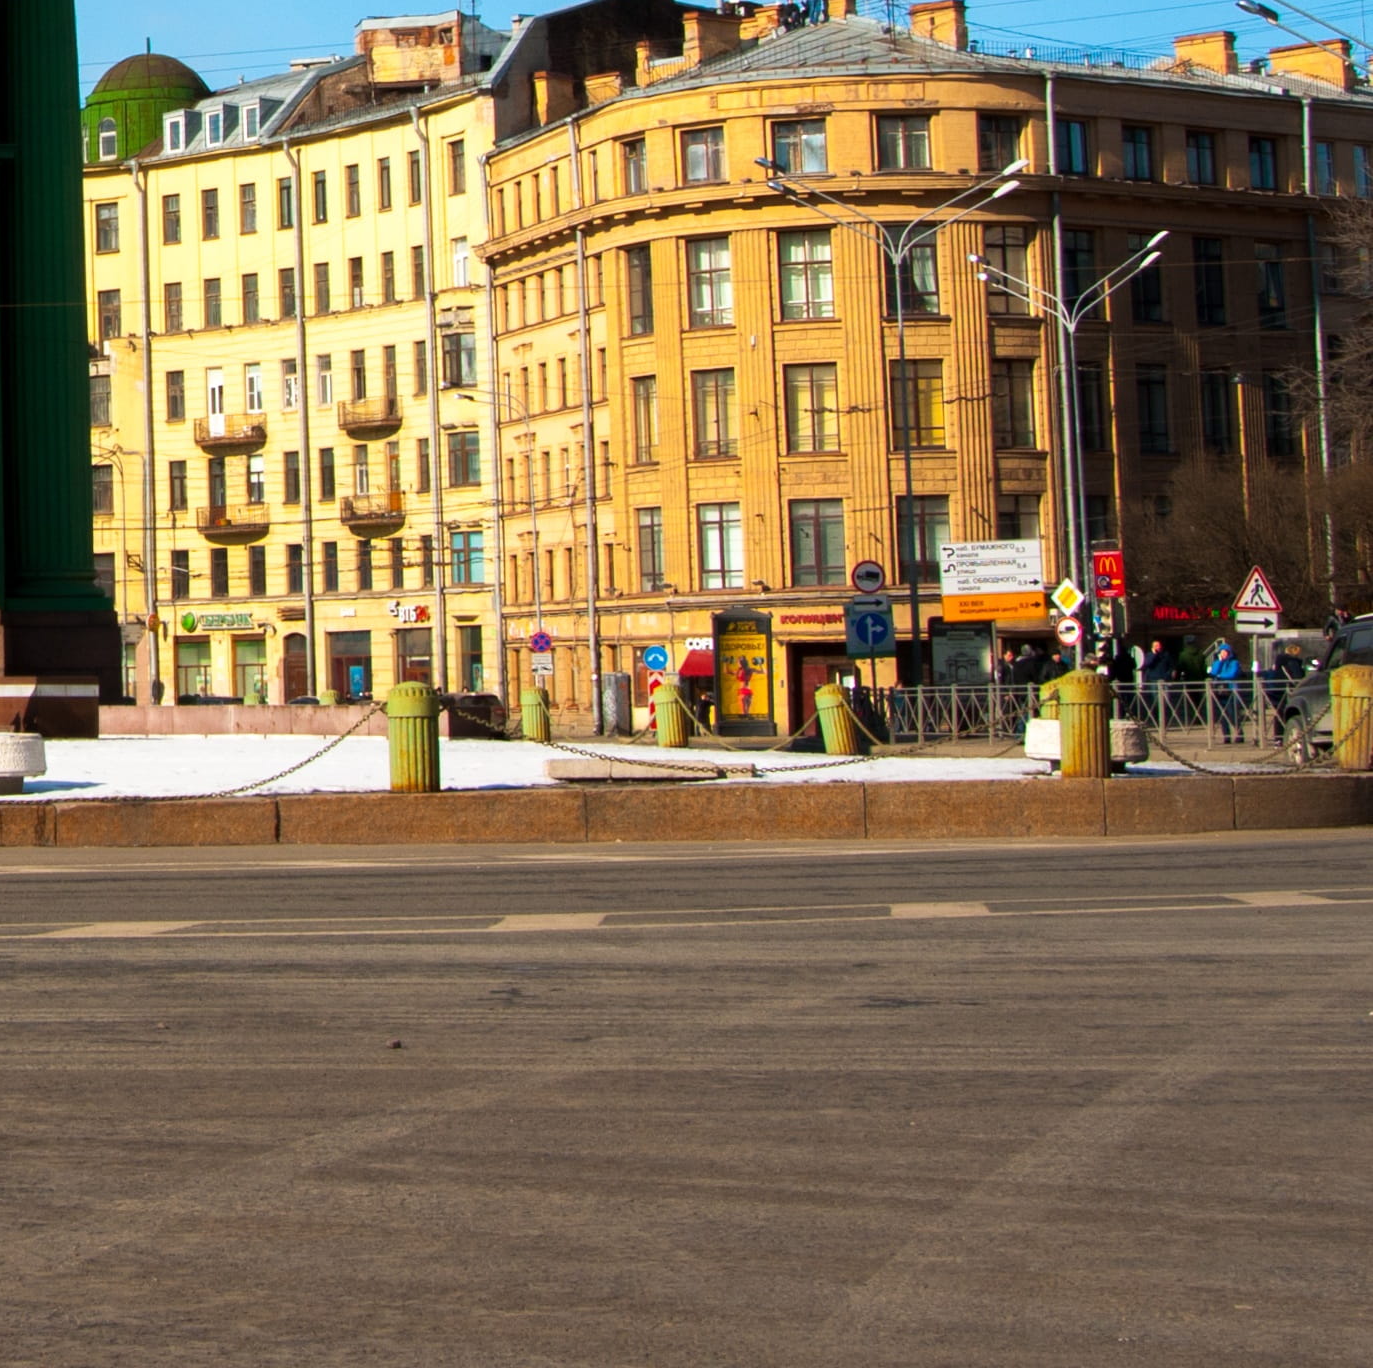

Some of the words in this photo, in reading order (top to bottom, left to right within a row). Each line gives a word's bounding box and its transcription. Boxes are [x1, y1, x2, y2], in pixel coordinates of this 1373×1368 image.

[971, 543, 1014, 551] БУМАЖНОГО
[956, 559, 1016, 568] ПРОМЫШЛЕННАЯ
[973, 576, 1017, 584] ОБВОДНОГО
